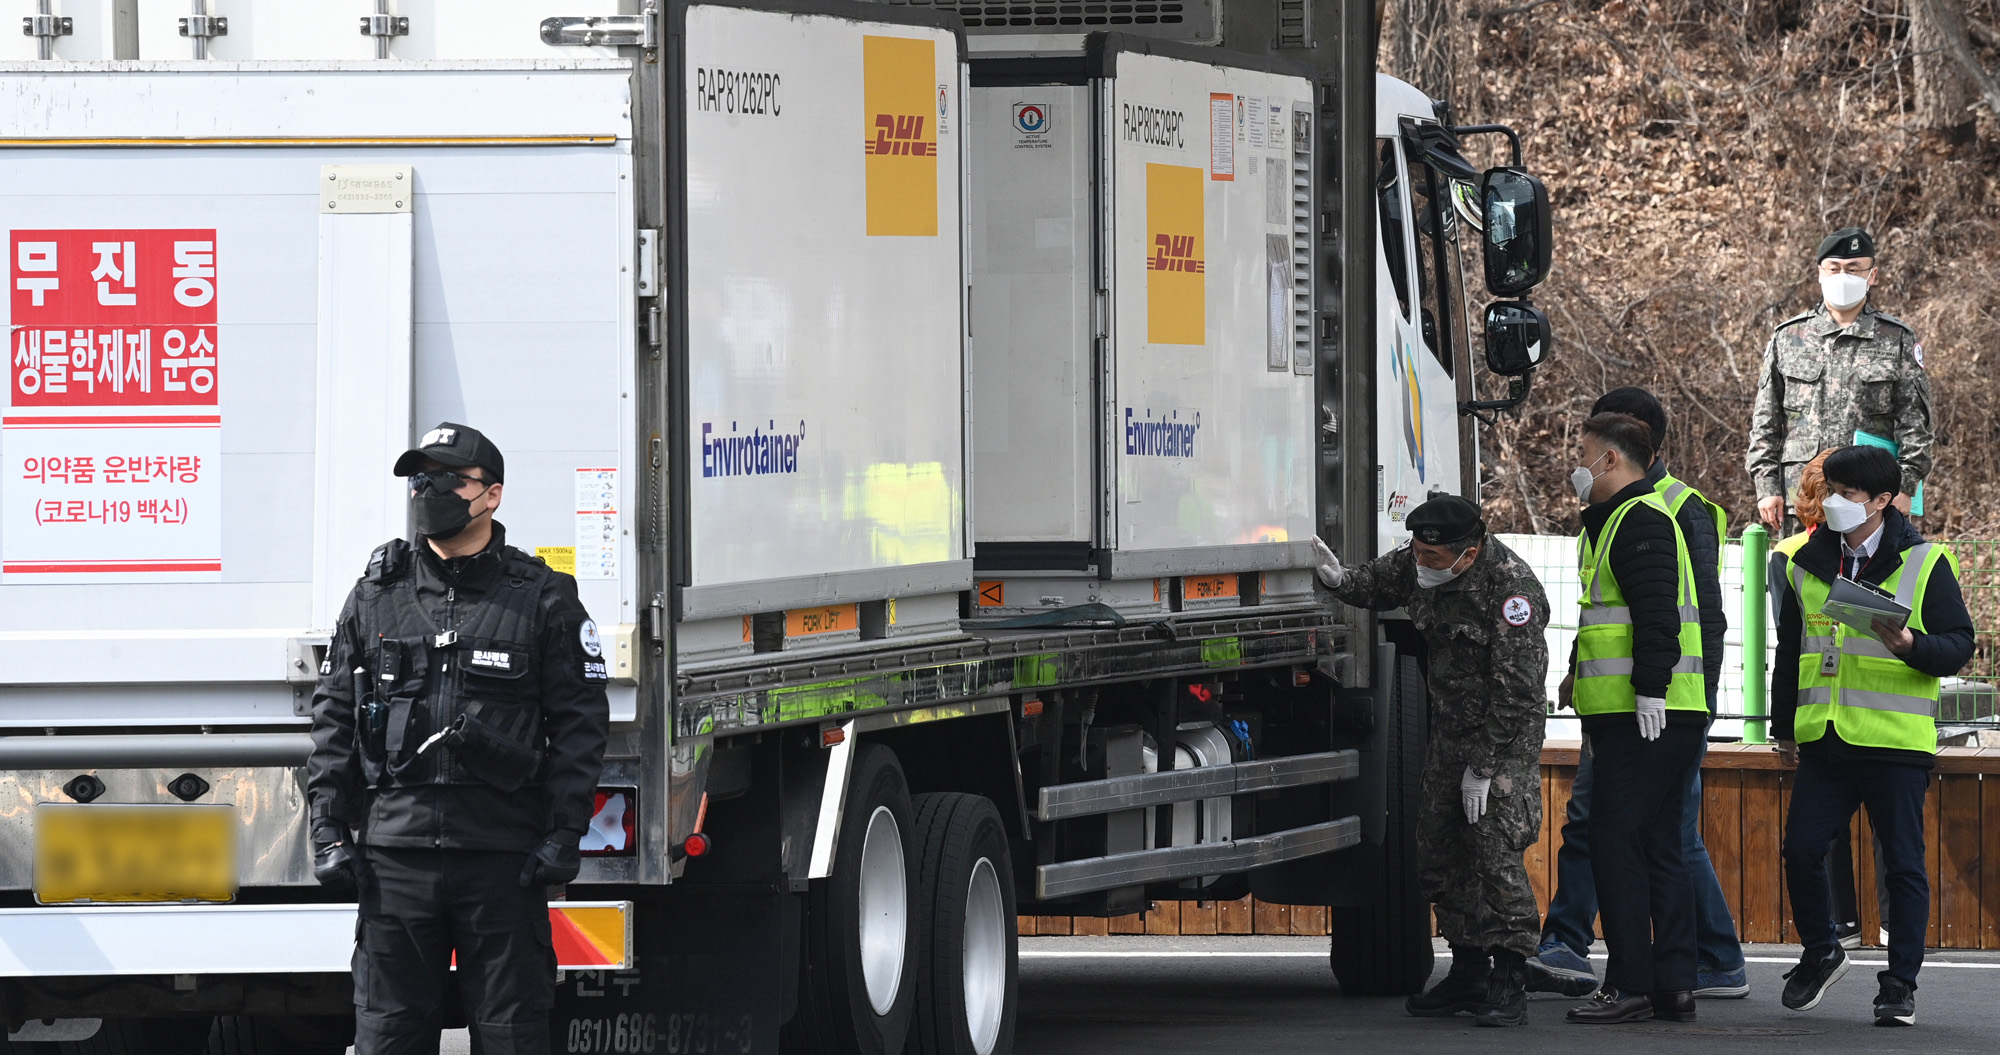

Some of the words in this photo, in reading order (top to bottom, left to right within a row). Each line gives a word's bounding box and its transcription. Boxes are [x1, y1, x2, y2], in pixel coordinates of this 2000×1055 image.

[697, 67, 781, 117] RAP81262PC
[874, 113, 928, 157] DHL
[1123, 103, 1184, 149] RAP80529PC
[1154, 233, 1198, 273] DHL
[14, 328, 152, 396] 생물학제제
[160, 328, 216, 394] 운송
[22, 456, 96, 485] 의약품
[102, 455, 201, 484] 운반차량
[34, 498, 131, 526] (코로나19
[136, 496, 189, 525] 백신)
[1394, 495, 1408, 508] FPT
[553, 547, 573, 555] 1500kg
[803, 614, 822, 632] FORK
[824, 611, 839, 629] LIFT
